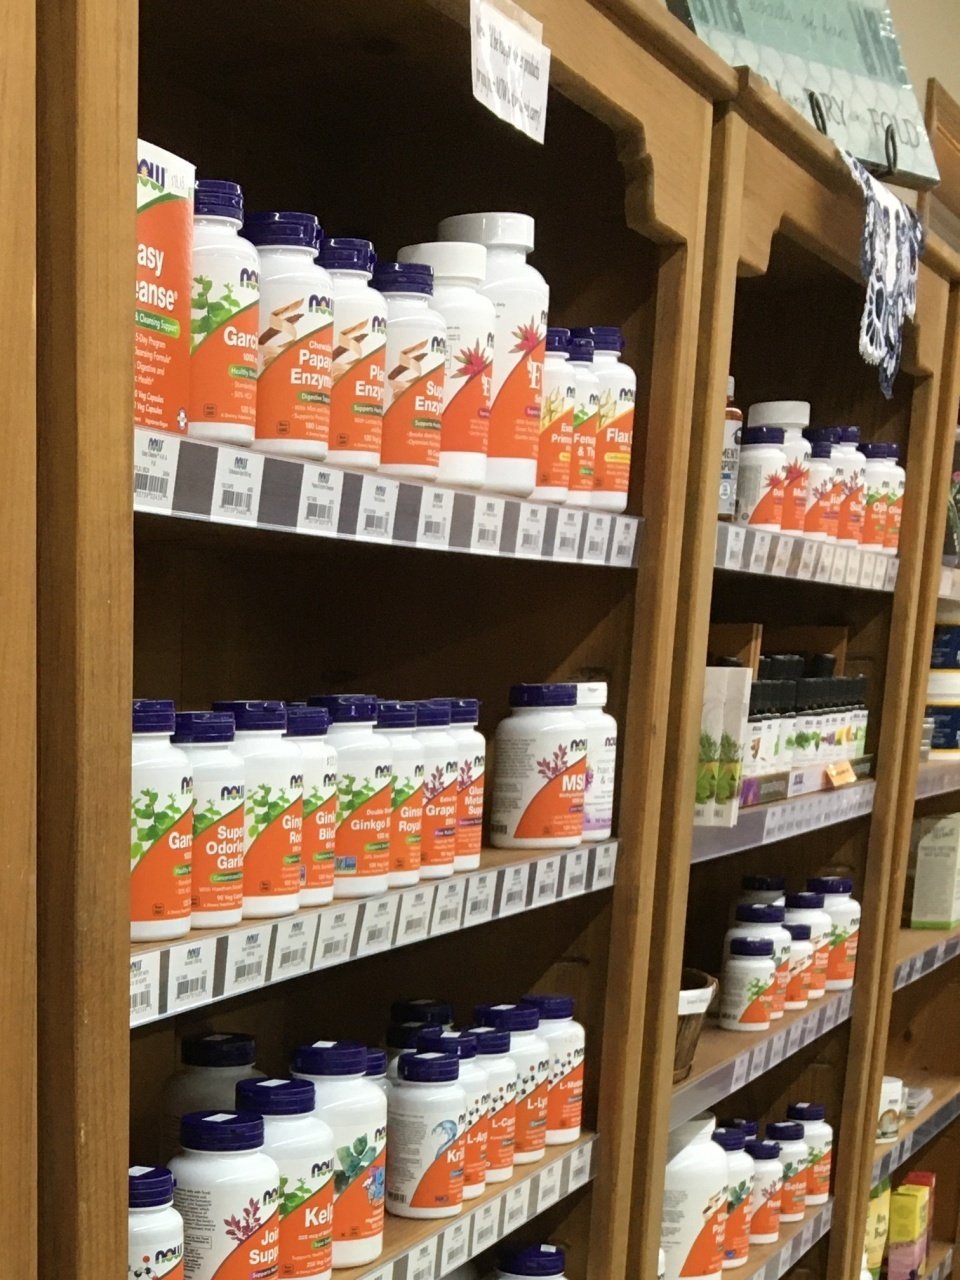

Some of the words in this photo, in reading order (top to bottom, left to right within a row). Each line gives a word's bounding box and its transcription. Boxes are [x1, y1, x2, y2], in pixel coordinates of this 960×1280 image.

[138, 244, 164, 277] asy
[426, 806, 454, 818] Grape
[351, 819, 386, 831] Ginkgo
